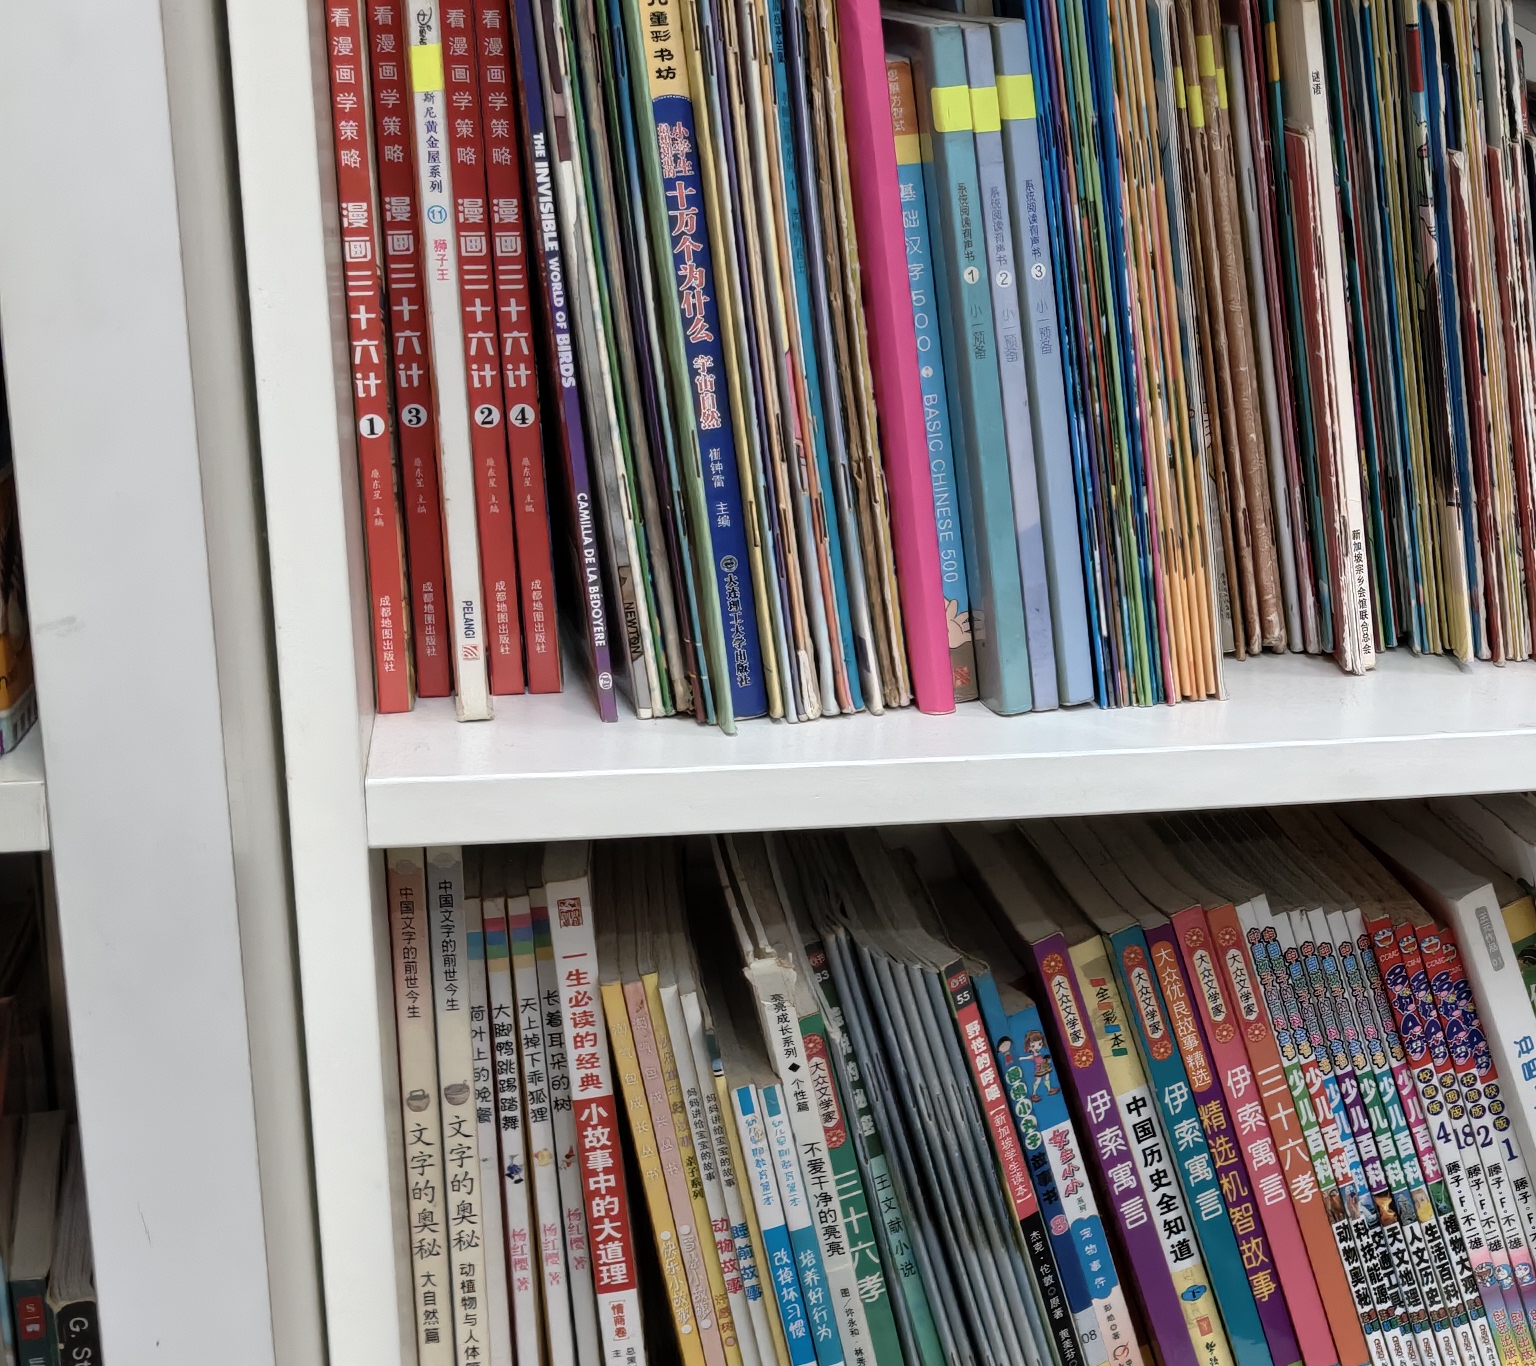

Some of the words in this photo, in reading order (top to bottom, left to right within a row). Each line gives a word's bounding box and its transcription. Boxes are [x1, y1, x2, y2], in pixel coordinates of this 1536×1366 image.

[329, 6, 361, 171] 看漫画学策略
[372, 5, 405, 165] 看漫画学策略
[444, 7, 476, 167] 看漫画学策略
[481, 7, 512, 167] 看漫画学策略
[532, 132, 546, 159] THE
[534, 159, 559, 253] INVISIBLE
[665, 180, 715, 345] 十万个为什么
[340, 200, 381, 400] 漫画三十六计
[383, 196, 424, 390] 漫画三十六计
[456, 197, 495, 391] 漫画三十六计
[493, 197, 532, 391] 漫画三十六计
[548, 254, 566, 310] WORLD
[555, 310, 568, 330] OF
[557, 331, 576, 388] BIRDS
[923, 393, 944, 452] BASIC
[931, 457, 955, 540] CHINESE
[941, 549, 960, 585] 500
[1351, 528, 1372, 655] 新加坡宗乡会馆联合总会
[560, 947, 605, 1093] 一生必读的经典
[963, 1018, 1002, 1103] 野性的呼唤
[407, 1119, 444, 1263] 文字的奥秘
[446, 1113, 480, 1253] 文字的奥秘
[579, 1101, 631, 1288] 小故事中的大道理
[803, 1140, 848, 1259] 不爱干净的亮亮
[1086, 1089, 1149, 1231] 伊索寓言
[1125, 1093, 1196, 1264] 中国历史全知道
[1164, 1080, 1224, 1222] 伊索寓言
[1199, 1097, 1278, 1304] 精选机智故事
[1224, 1064, 1287, 1206] 伊索寓言
[1256, 1066, 1316, 1206] 三十六孝
